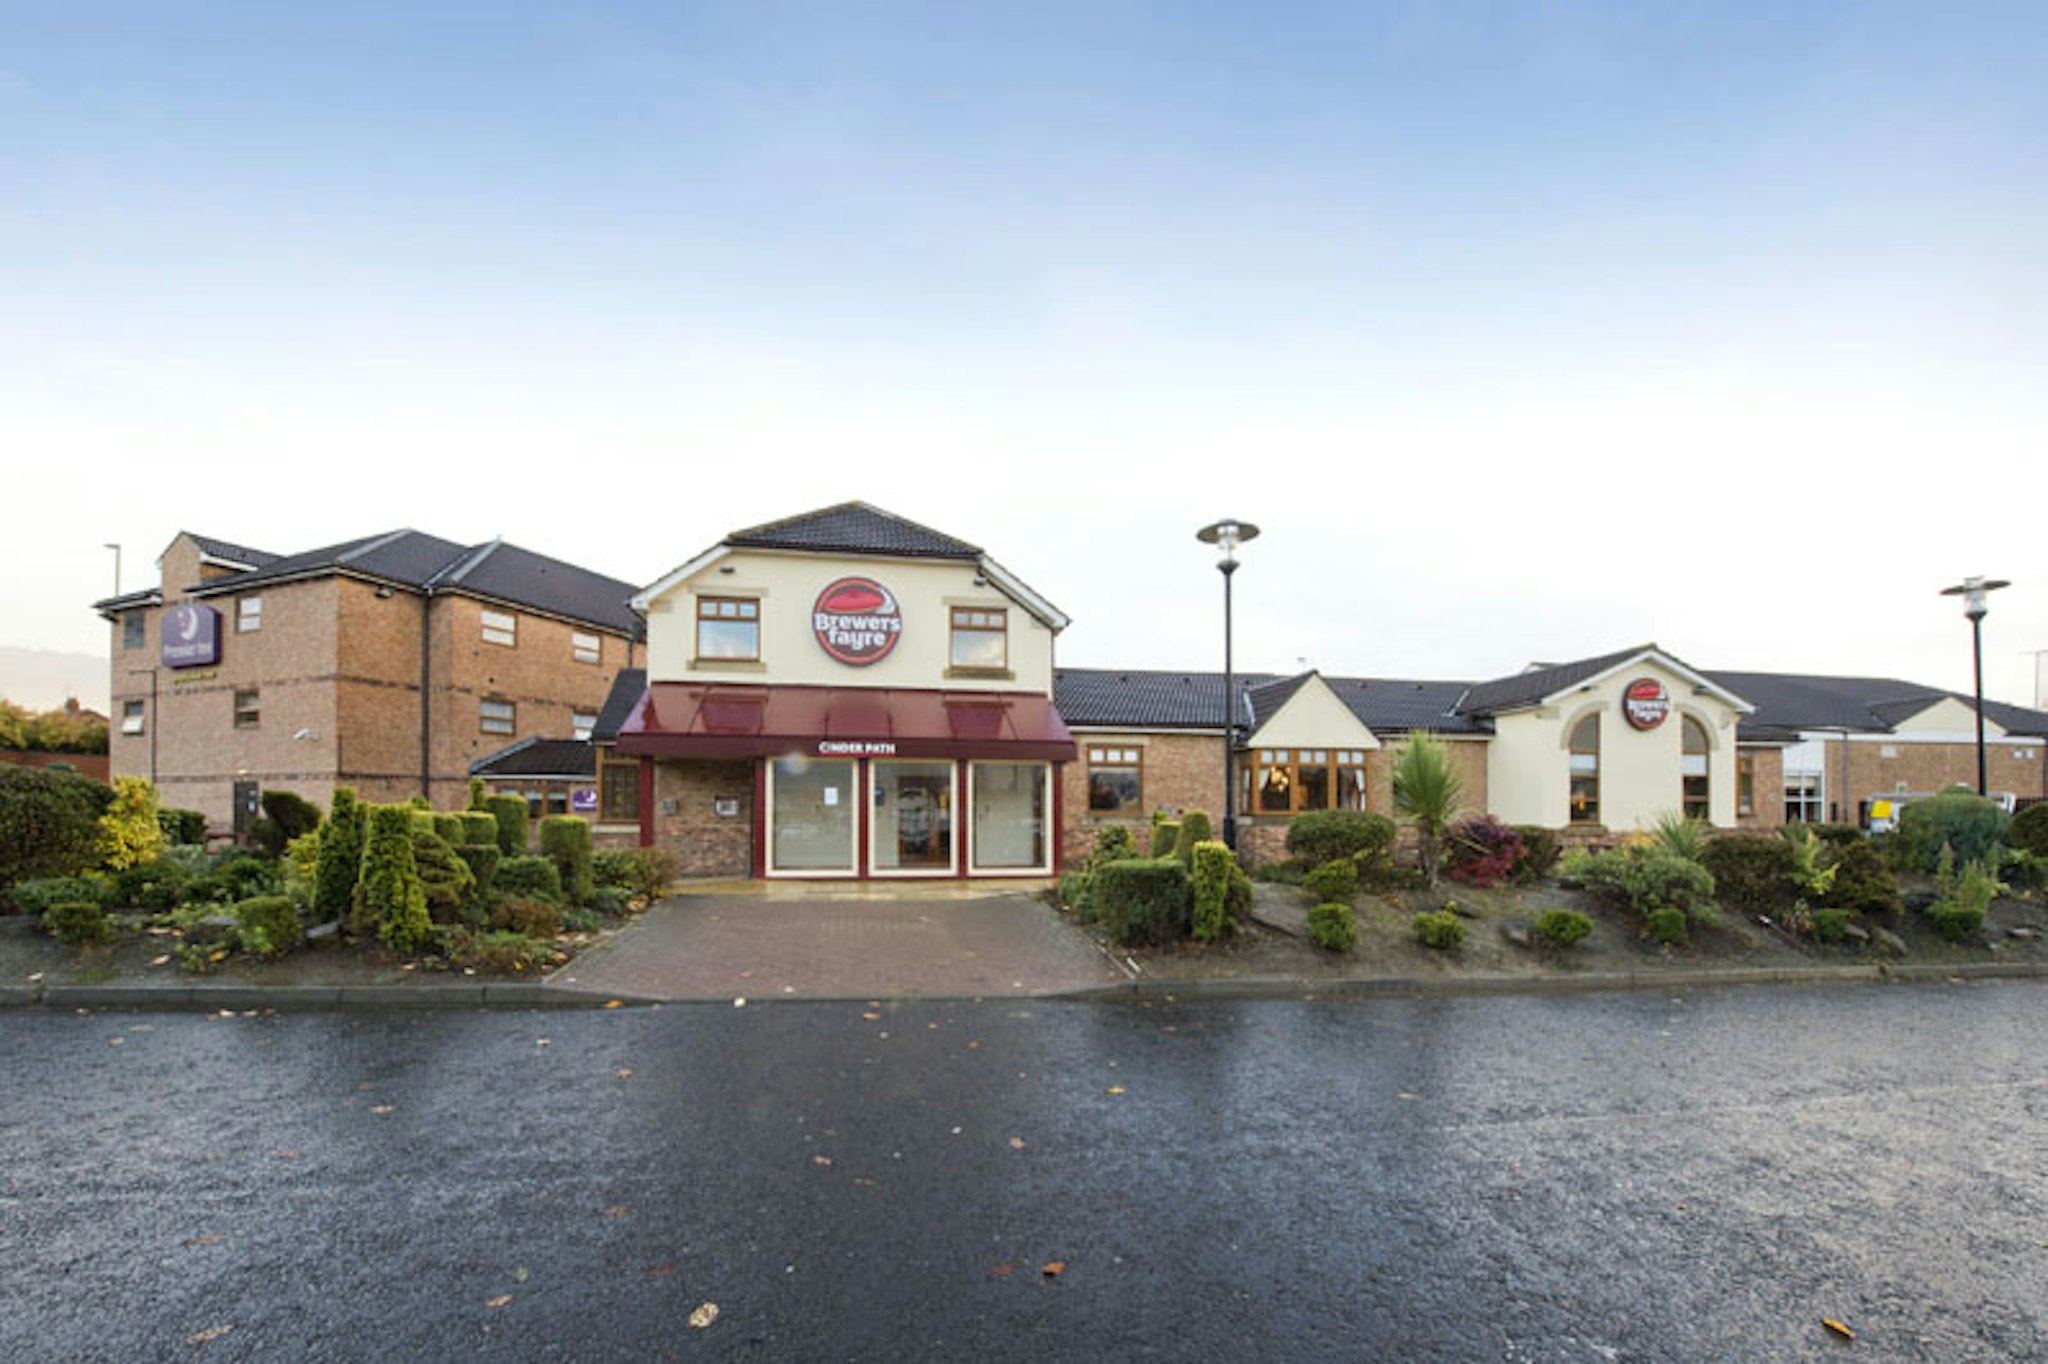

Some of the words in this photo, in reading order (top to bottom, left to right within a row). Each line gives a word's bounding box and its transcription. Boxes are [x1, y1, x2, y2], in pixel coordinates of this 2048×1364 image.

[813, 612, 901, 632] Brewers
[818, 741, 864, 754] CINDER
[865, 743, 896, 755] PATH
